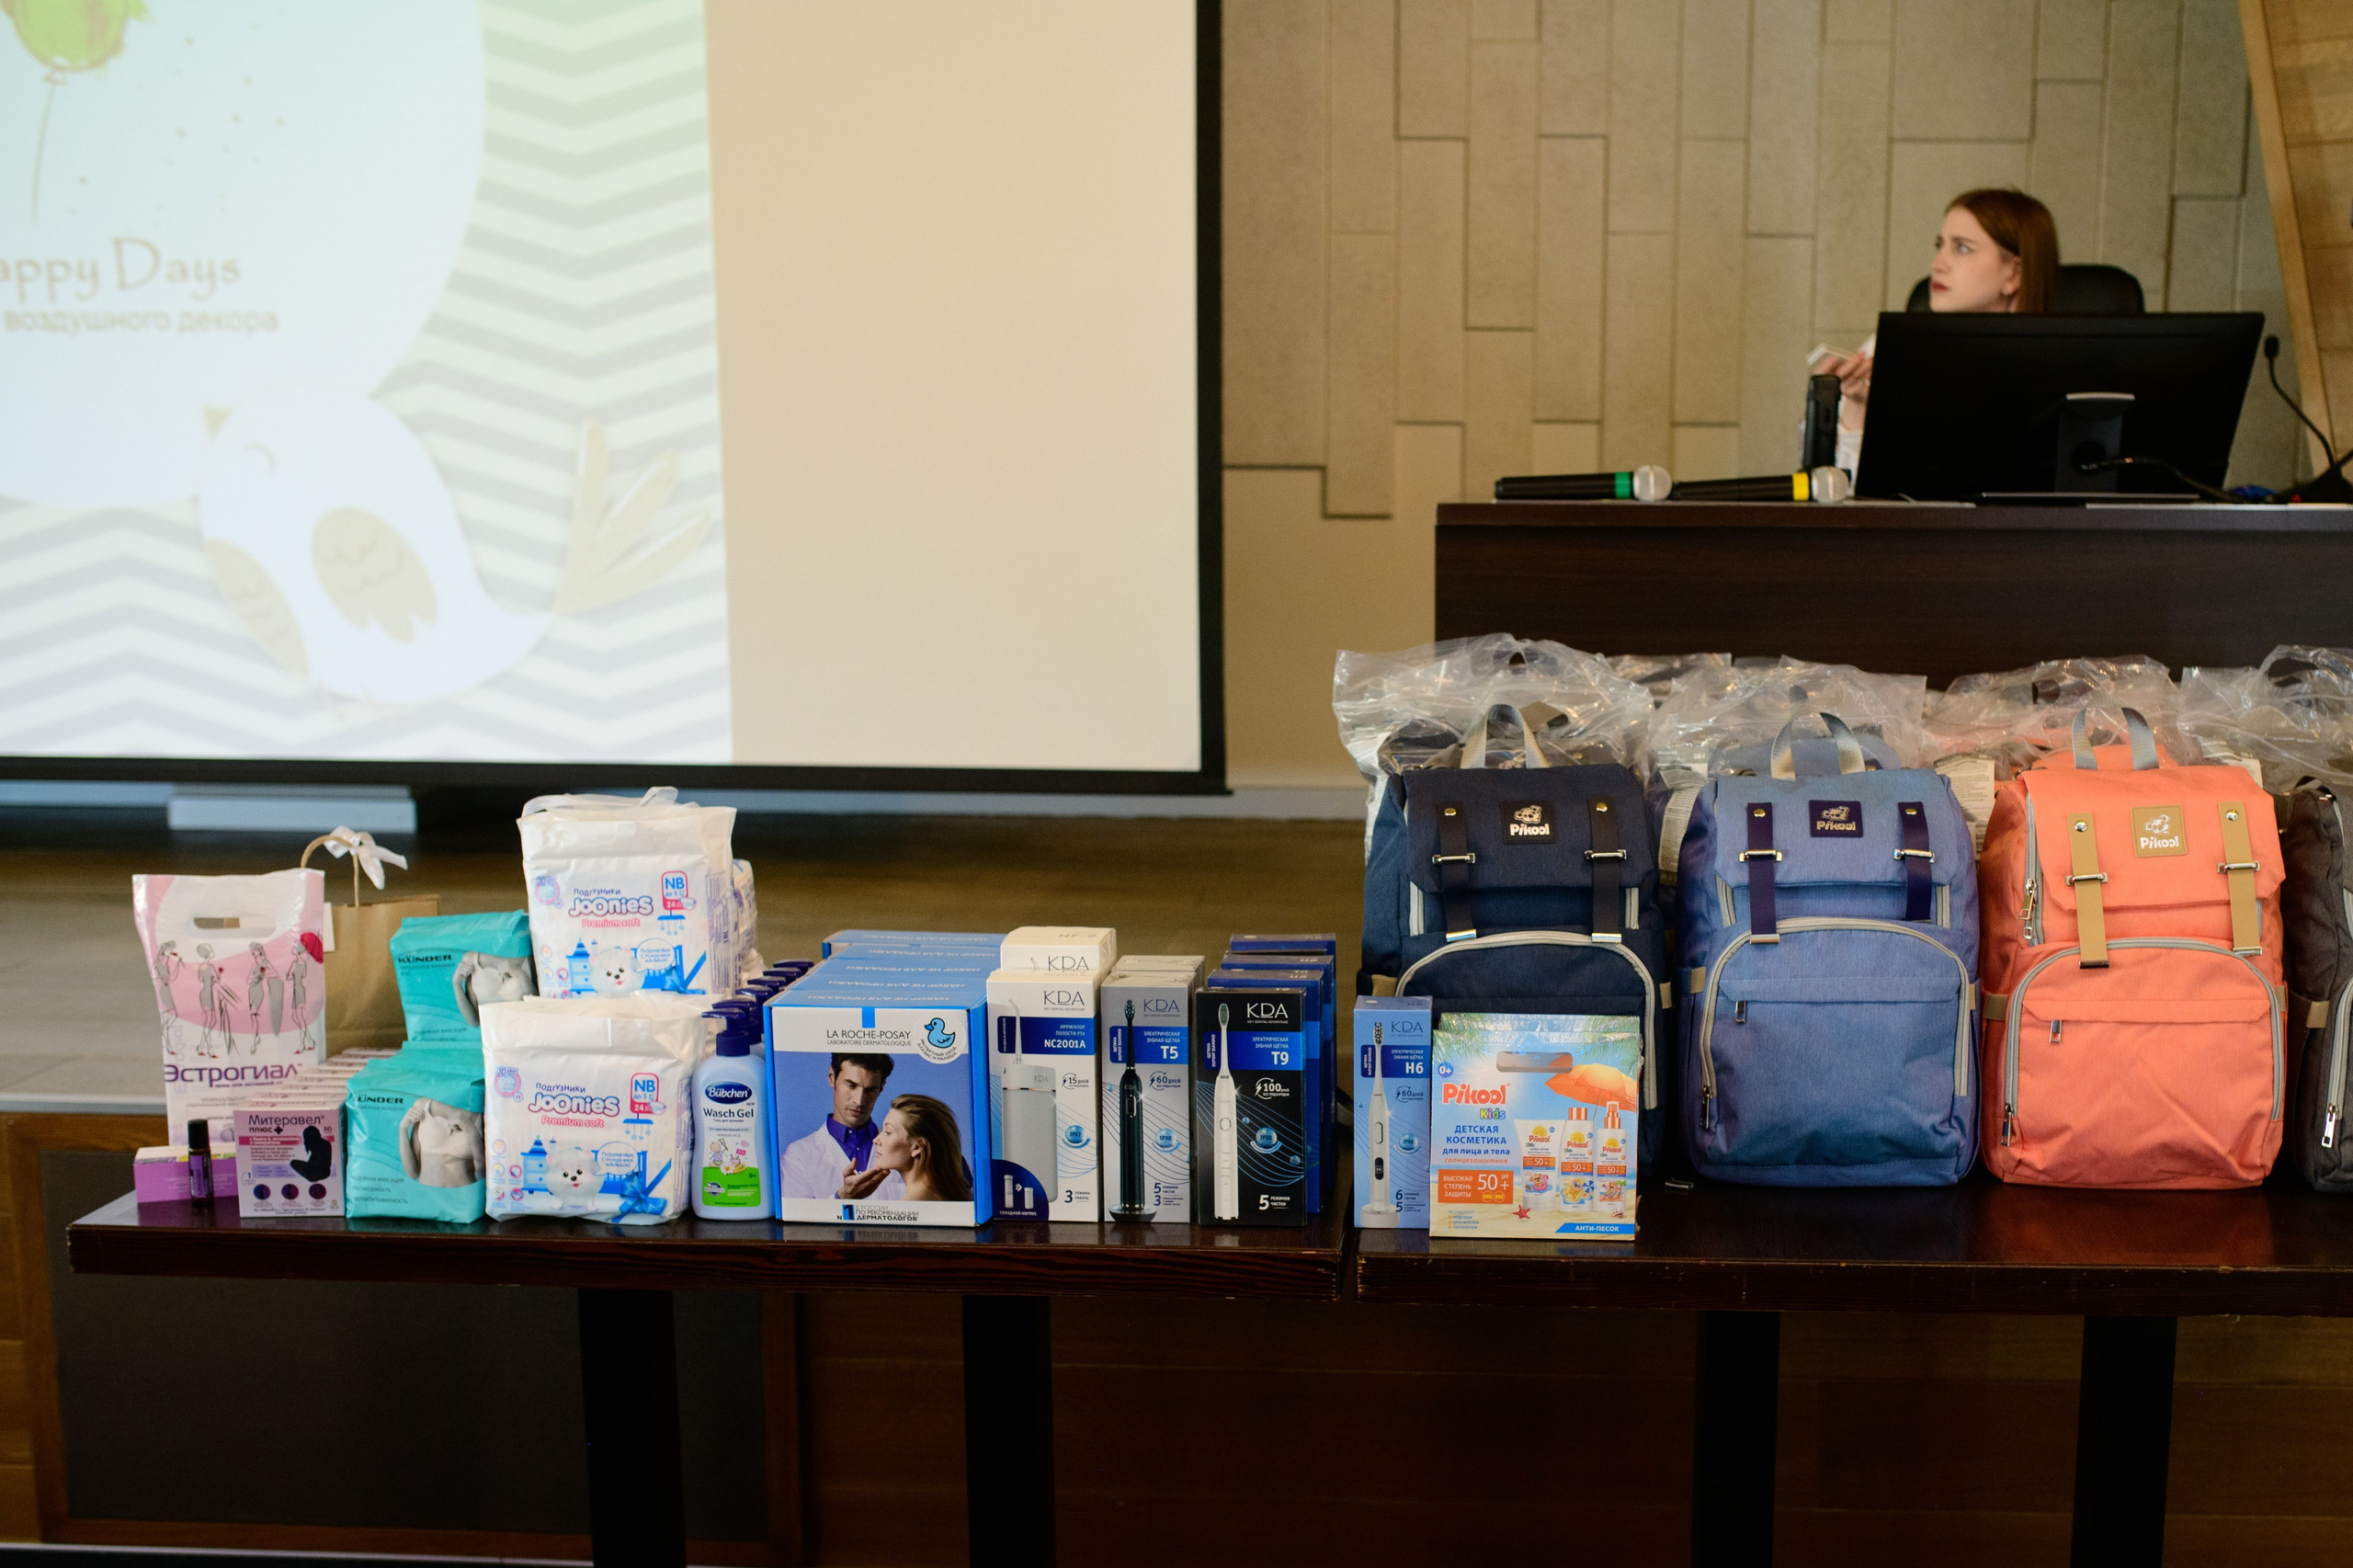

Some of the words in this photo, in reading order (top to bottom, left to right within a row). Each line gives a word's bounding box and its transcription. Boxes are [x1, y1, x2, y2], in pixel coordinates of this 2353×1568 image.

[112, 236, 243, 301] Days
[1510, 824, 1550, 835] Pikool
[1816, 821, 1857, 831] Pikool
[2140, 835, 2179, 849] Pikool
[665, 877, 685, 890] NB
[582, 918, 620, 927] Premium
[621, 919, 641, 927] soft
[1048, 956, 1089, 971] KDA
[1044, 990, 1085, 1006] KDA
[1143, 999, 1180, 1012] KDA
[1246, 1003, 1289, 1018] KDA
[1392, 1021, 1423, 1033] KDA
[826, 1030, 838, 1039] LA
[841, 1030, 912, 1040] ROCHE-POSAY
[1044, 1040, 1086, 1049] NC2001A
[1161, 1046, 1178, 1060] T5
[1271, 1051, 1289, 1065] T9
[1405, 1062, 1424, 1074] H6
[1439, 1066, 1451, 1074] 0+
[164, 1063, 298, 1087] Эстрогиал
[1156, 1075, 1167, 1084] 60
[634, 1079, 655, 1092] NB
[1263, 1083, 1281, 1092] 100
[708, 1086, 748, 1098] Bübchen
[1442, 1083, 1506, 1105] Pikool
[354, 1094, 404, 1104] ÜNDER
[703, 1108, 735, 1118] Wasch
[736, 1108, 754, 1118] Gel
[1480, 1108, 1506, 1119] Kids
[248, 1115, 321, 1128] Митеравел
[541, 1115, 583, 1127] Premium
[584, 1118, 604, 1128] soft
[1455, 1125, 1499, 1134] ДЕТСКАЯ
[1446, 1136, 1506, 1144] КОСМЕТИКА
[1154, 1183, 1161, 1193] 5
[1064, 1189, 1074, 1203] 3
[1154, 1195, 1161, 1206] 3
[1395, 1189, 1403, 1200] 6
[1258, 1194, 1269, 1210] 5
[1395, 1202, 1403, 1212] 5
